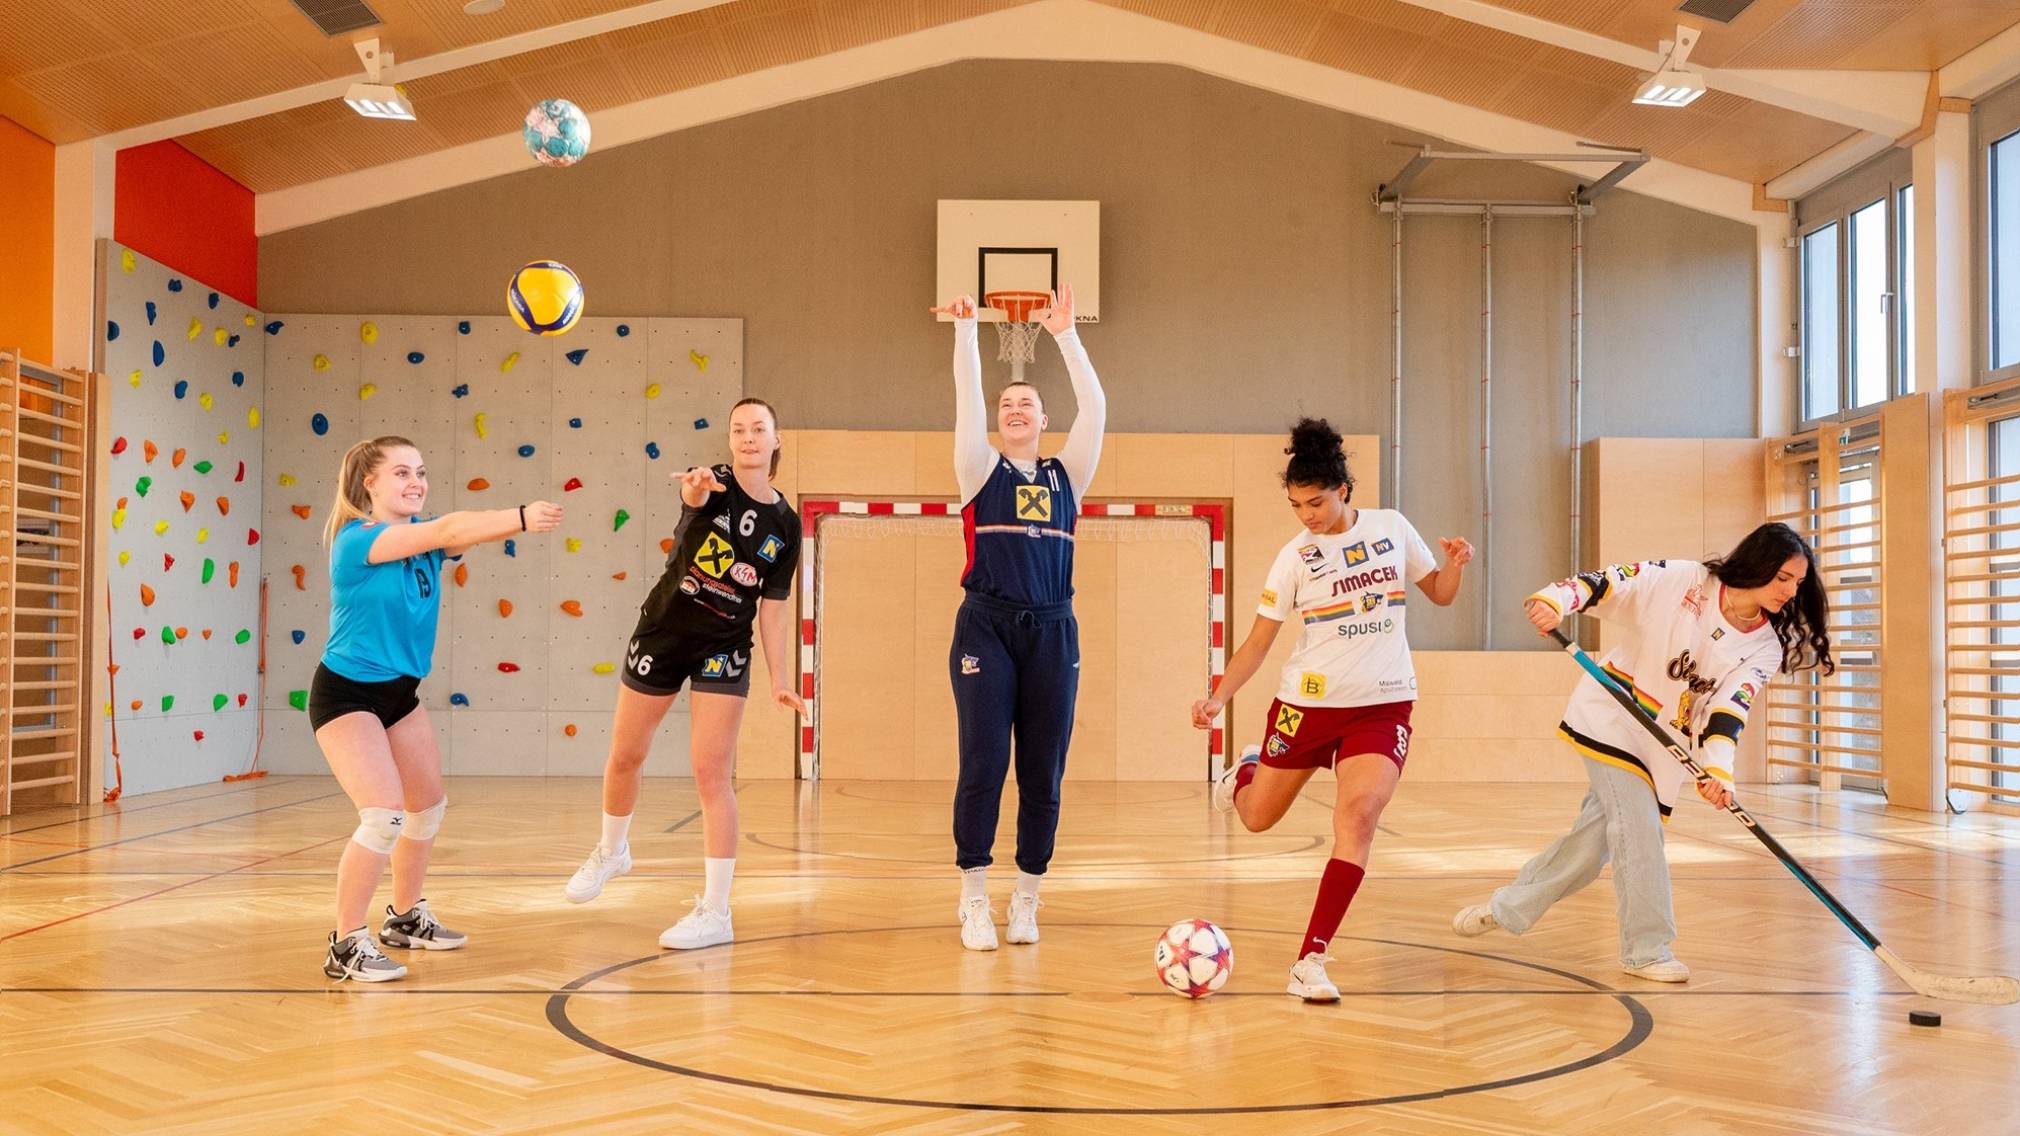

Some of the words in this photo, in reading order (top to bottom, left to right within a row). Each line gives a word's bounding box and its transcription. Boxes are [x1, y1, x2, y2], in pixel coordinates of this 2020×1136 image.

[739, 509, 758, 537] 6
[1331, 565, 1398, 597] SIMACEK
[637, 654, 653, 676] 6
